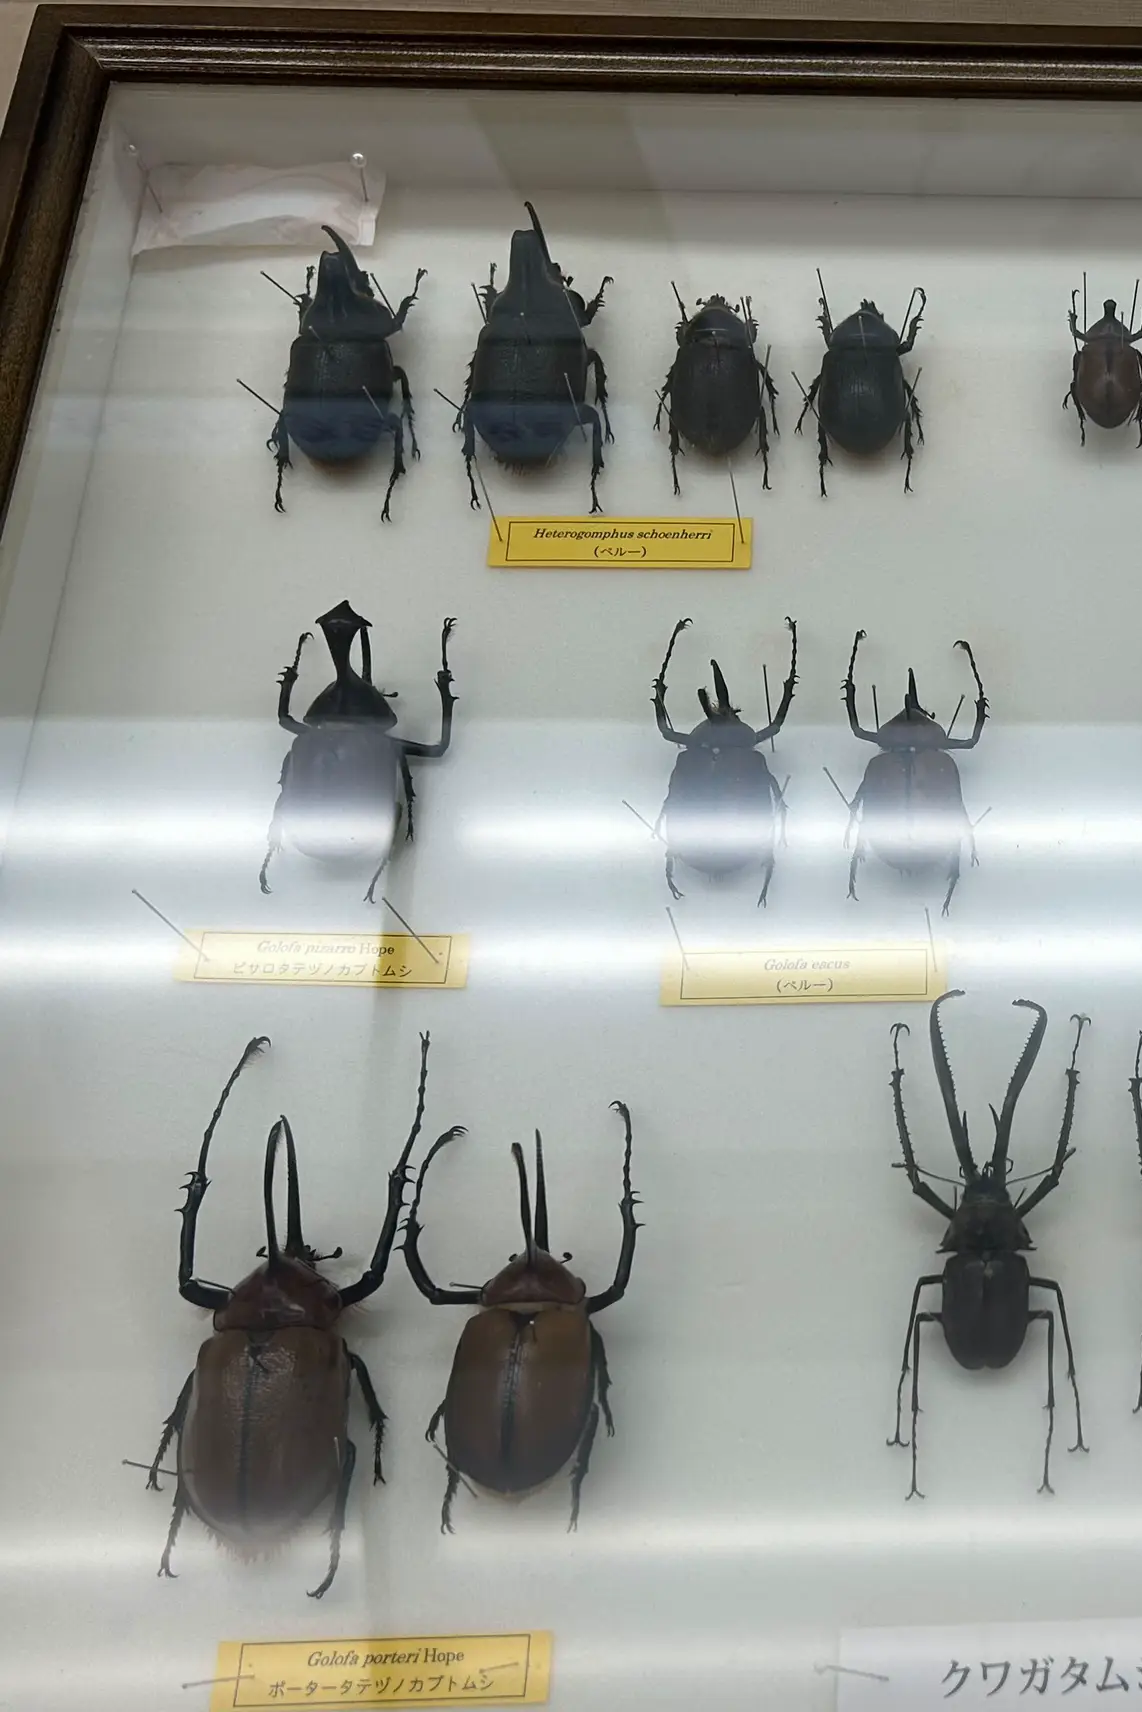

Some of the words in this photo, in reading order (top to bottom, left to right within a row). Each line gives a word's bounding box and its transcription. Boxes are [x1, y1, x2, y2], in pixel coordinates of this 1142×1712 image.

[533, 527, 634, 541] Heterogomphus
[636, 529, 712, 540] schoenherri
[593, 545, 647, 558] (ペルー)
[256, 940, 302, 954] Golofa
[359, 943, 395, 957] Hope
[764, 958, 808, 971] Golofa
[811, 959, 851, 971] eacus
[776, 978, 834, 992] (ペルー)
[307, 1651, 359, 1667] Golofa
[363, 1648, 420, 1666] porteri
[424, 1648, 465, 1664] Hope
[268, 1676, 494, 1698] ポータータテヅノカブトムシ
